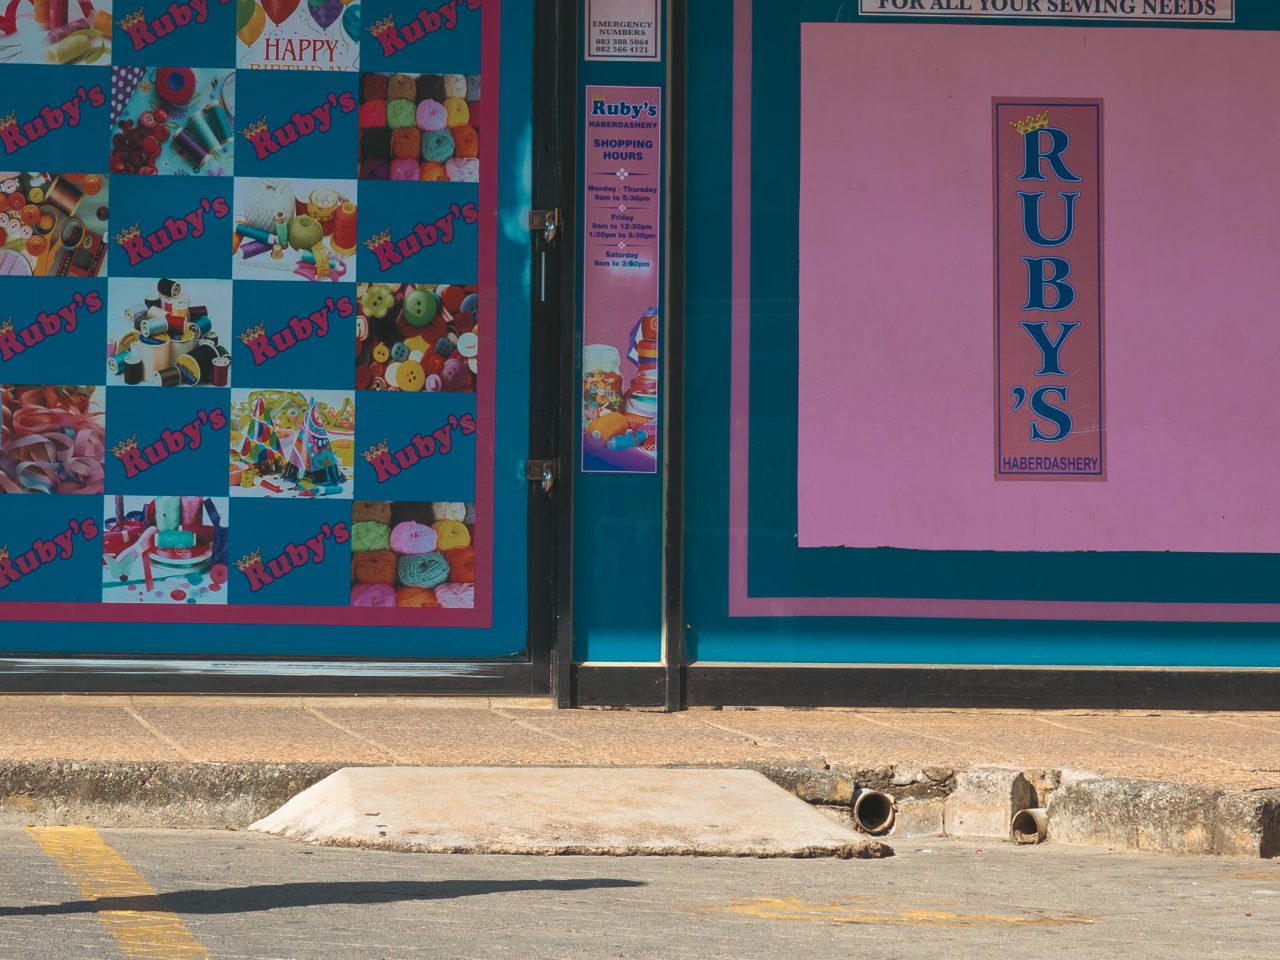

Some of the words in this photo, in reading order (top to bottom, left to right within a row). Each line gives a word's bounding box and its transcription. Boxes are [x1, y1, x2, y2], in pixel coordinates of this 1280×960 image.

[592, 20, 653, 28] EMERGENCY
[264, 38, 338, 62] HAPPY
[0, 85, 106, 155] Ruby's
[591, 100, 657, 120] Ruby's
[249, 91, 357, 160] Ruby's
[589, 121, 657, 129] HABERDASHERY
[593, 139, 653, 149] SHOPPING
[603, 152, 644, 161] HOURS
[588, 185, 616, 193] Monday
[623, 186, 657, 194] Thursday
[611, 214, 634, 222] Friday
[121, 196, 230, 266] Ruby's
[372, 202, 479, 271] Ruby's
[605, 251, 639, 259] Saturday
[1011, 126, 1082, 442] RUBY'S
[247, 296, 354, 366] Ruby's
[120, 407, 227, 479] Ruby's
[370, 413, 477, 482] Ruby's
[1003, 456, 1099, 472] HABERDASHERY
[240, 521, 350, 593] Ruby's
